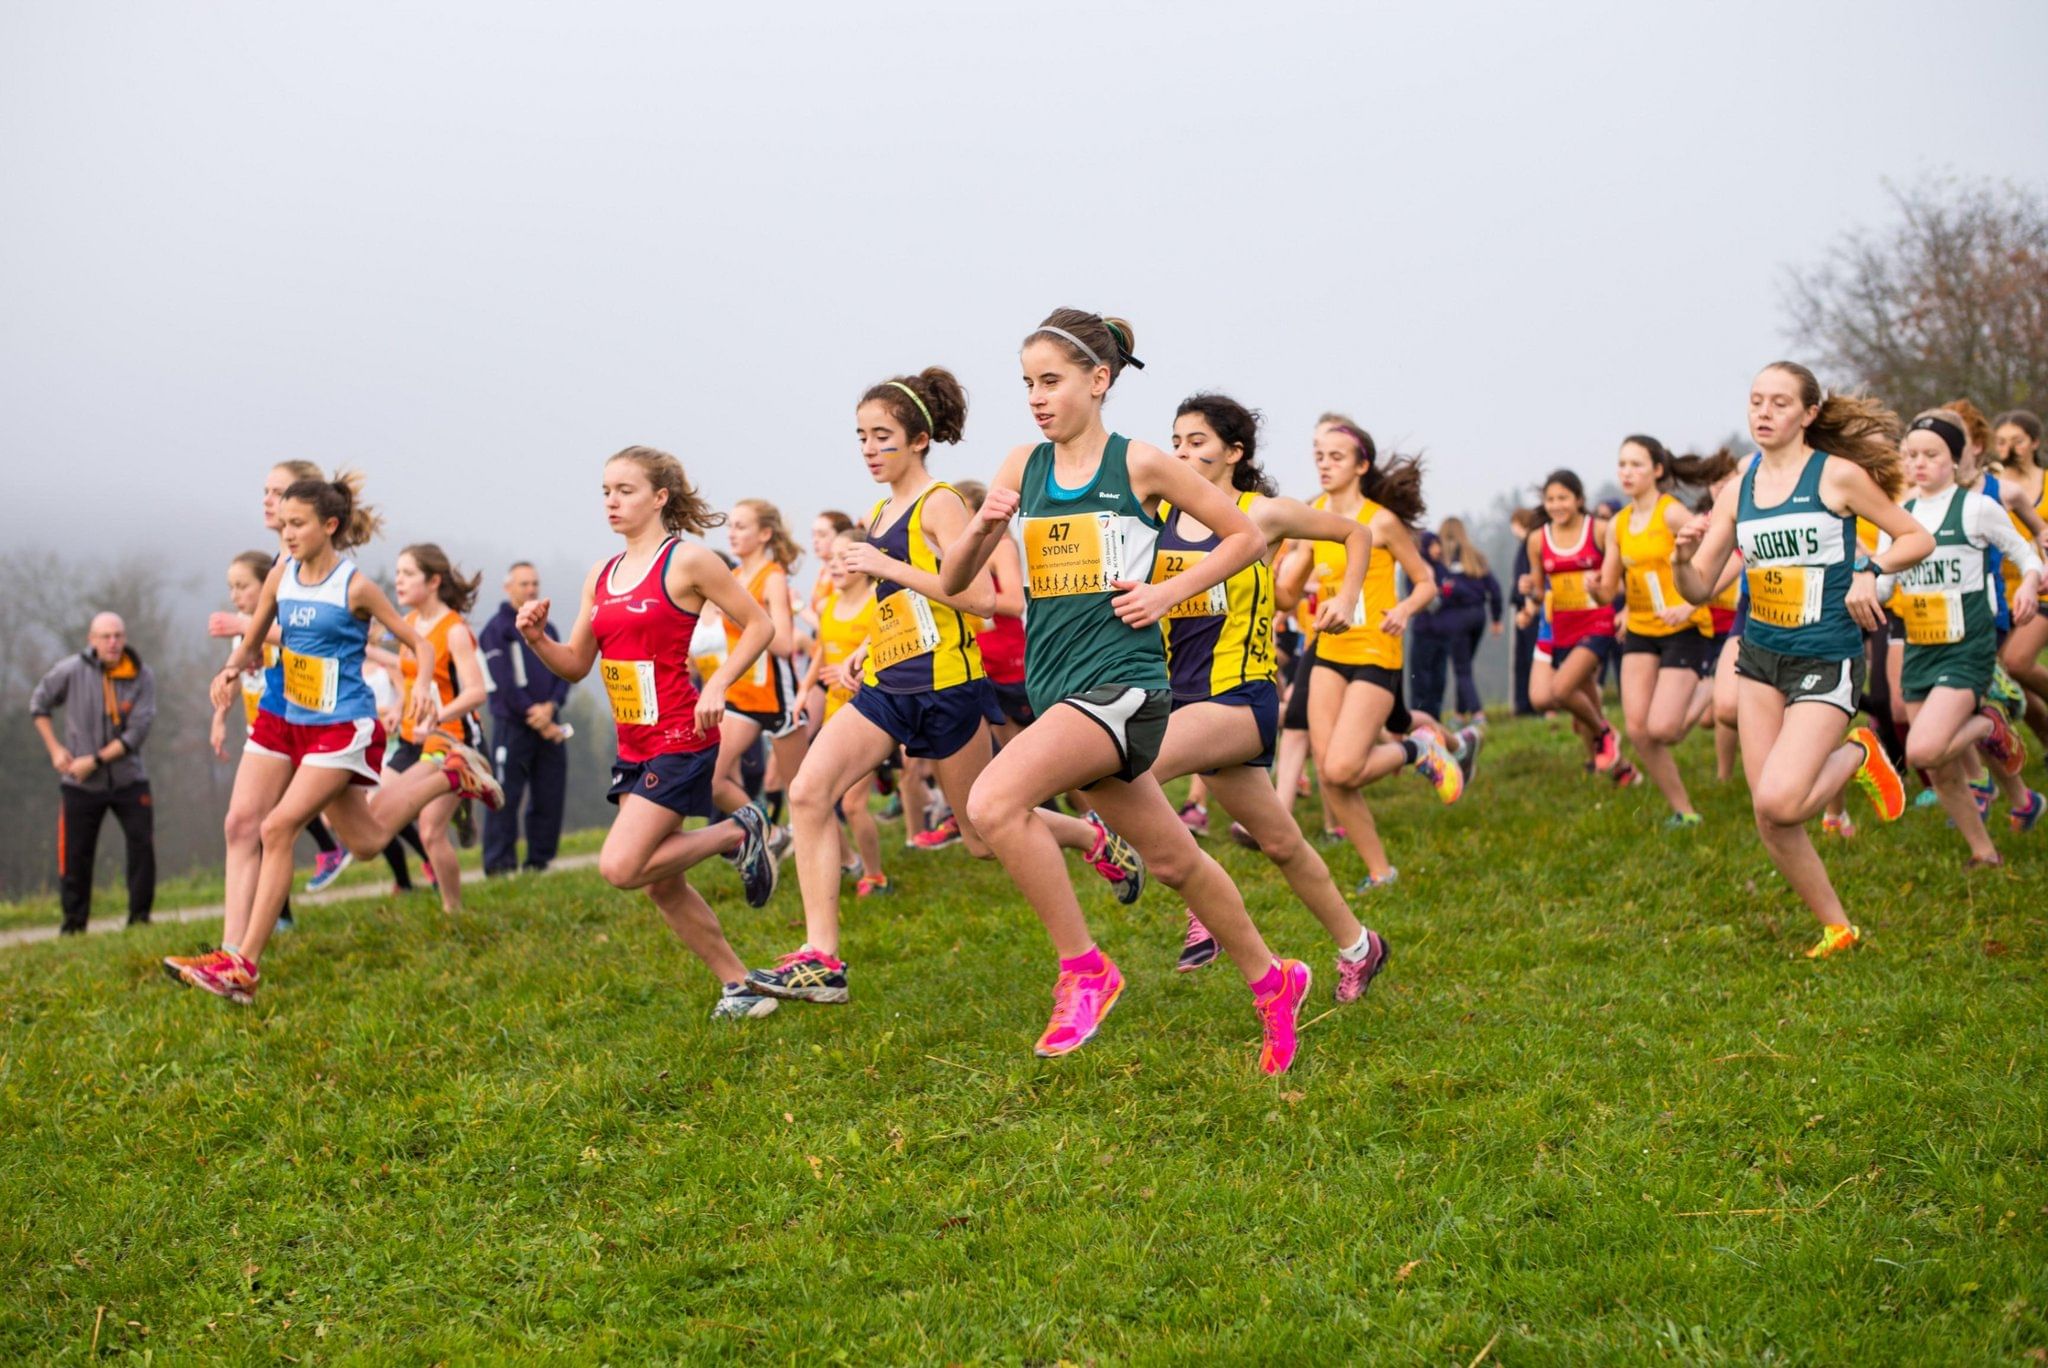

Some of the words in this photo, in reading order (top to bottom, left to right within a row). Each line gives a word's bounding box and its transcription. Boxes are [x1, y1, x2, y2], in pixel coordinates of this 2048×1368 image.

[1048, 522, 1071, 541] 47
[1042, 543, 1080, 557] SYDNEY
[1753, 527, 1819, 560] JOHN'S
[1049, 559, 1081, 569] International
[1082, 557, 1100, 565] School
[1165, 556, 1185, 572] 22
[1764, 571, 1783, 585] 45
[288, 605, 317, 627] ASP
[879, 603, 894, 622] 25
[293, 658, 307, 671] 20
[605, 666, 620, 681] 28
